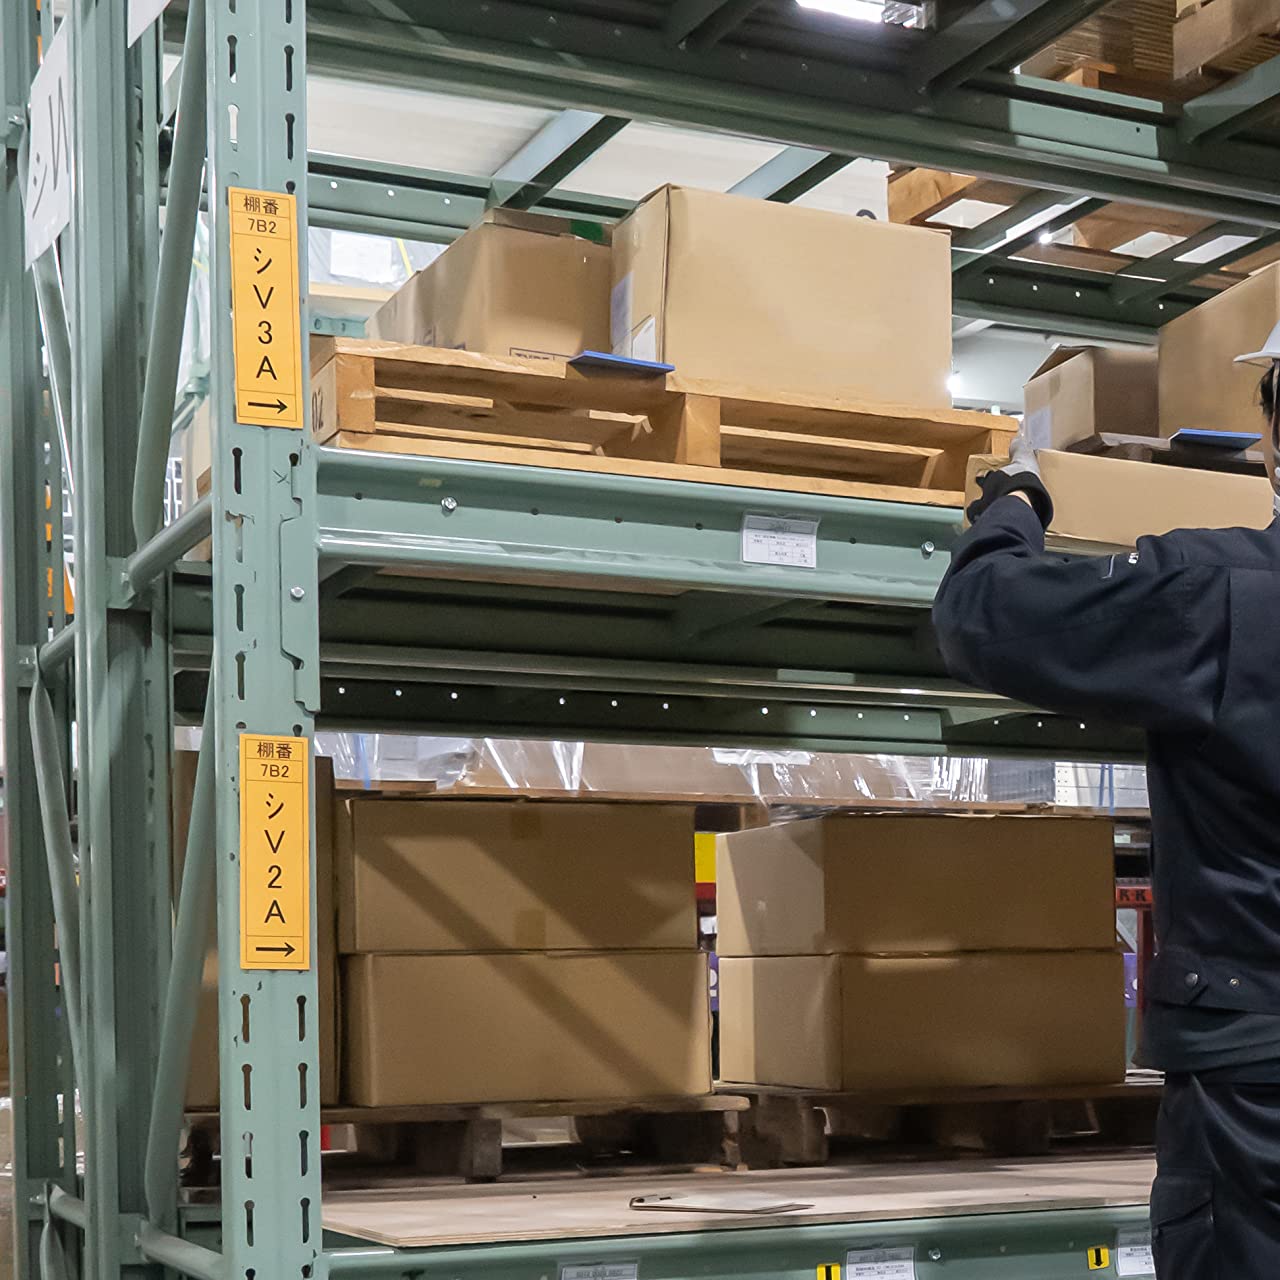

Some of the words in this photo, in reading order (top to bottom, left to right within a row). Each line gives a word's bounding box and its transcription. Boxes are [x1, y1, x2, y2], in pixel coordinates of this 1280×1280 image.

[243, 195, 279, 216] 棚番
[247, 218, 277, 234] 7B2
[253, 247, 278, 381] シV3A
[256, 741, 293, 760] 棚番
[260, 763, 290, 778] 7B2
[263, 793, 286, 924] シV2A
